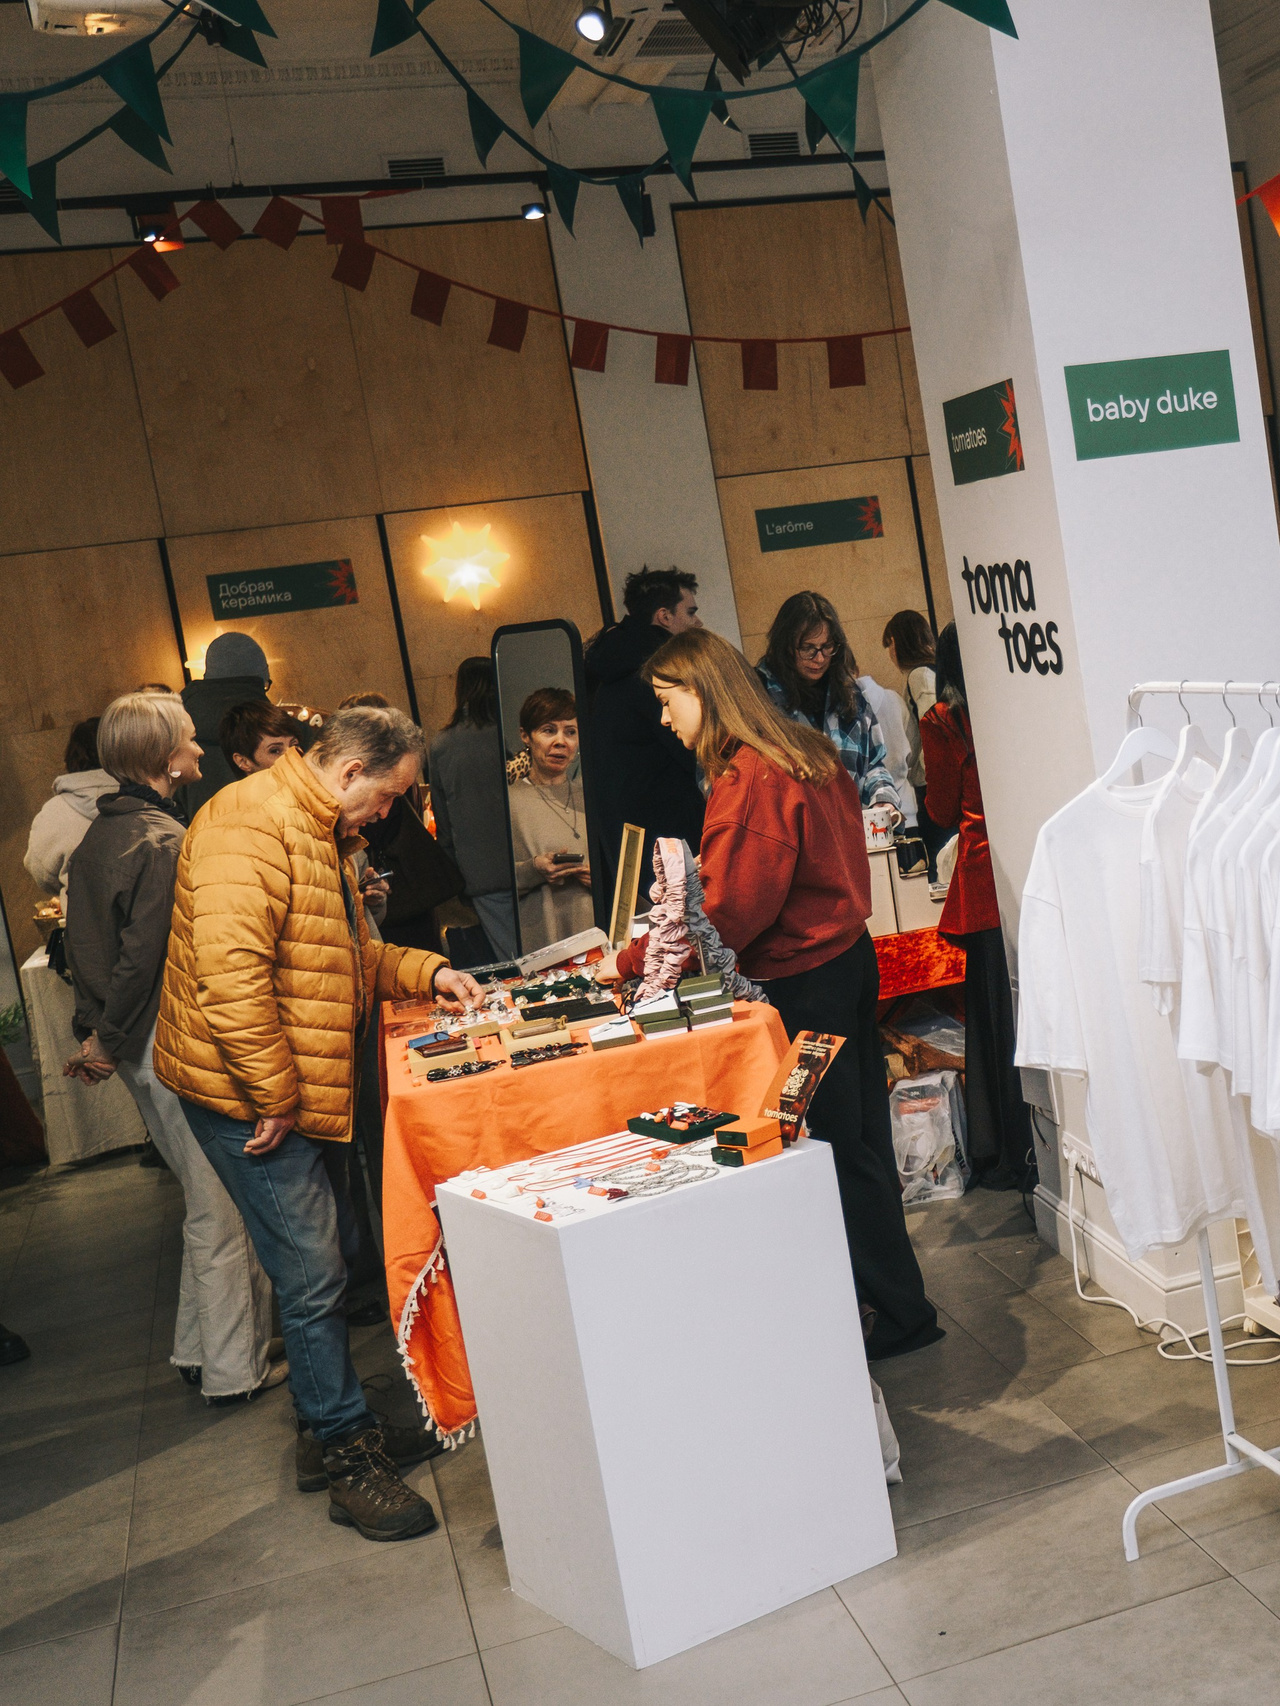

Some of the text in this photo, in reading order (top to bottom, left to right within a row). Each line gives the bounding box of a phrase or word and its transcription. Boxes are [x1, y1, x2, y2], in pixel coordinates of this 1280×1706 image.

[1086, 387, 1218, 423] baby duke
[951, 427, 987, 453] tomatoes
[765, 521, 814, 536] L'arôme
[219, 580, 274, 598] Добрая
[961, 555, 1036, 615] toma
[221, 591, 293, 610] керамика
[998, 612, 1064, 676] toes
[764, 1108, 799, 1123] tomatoes
